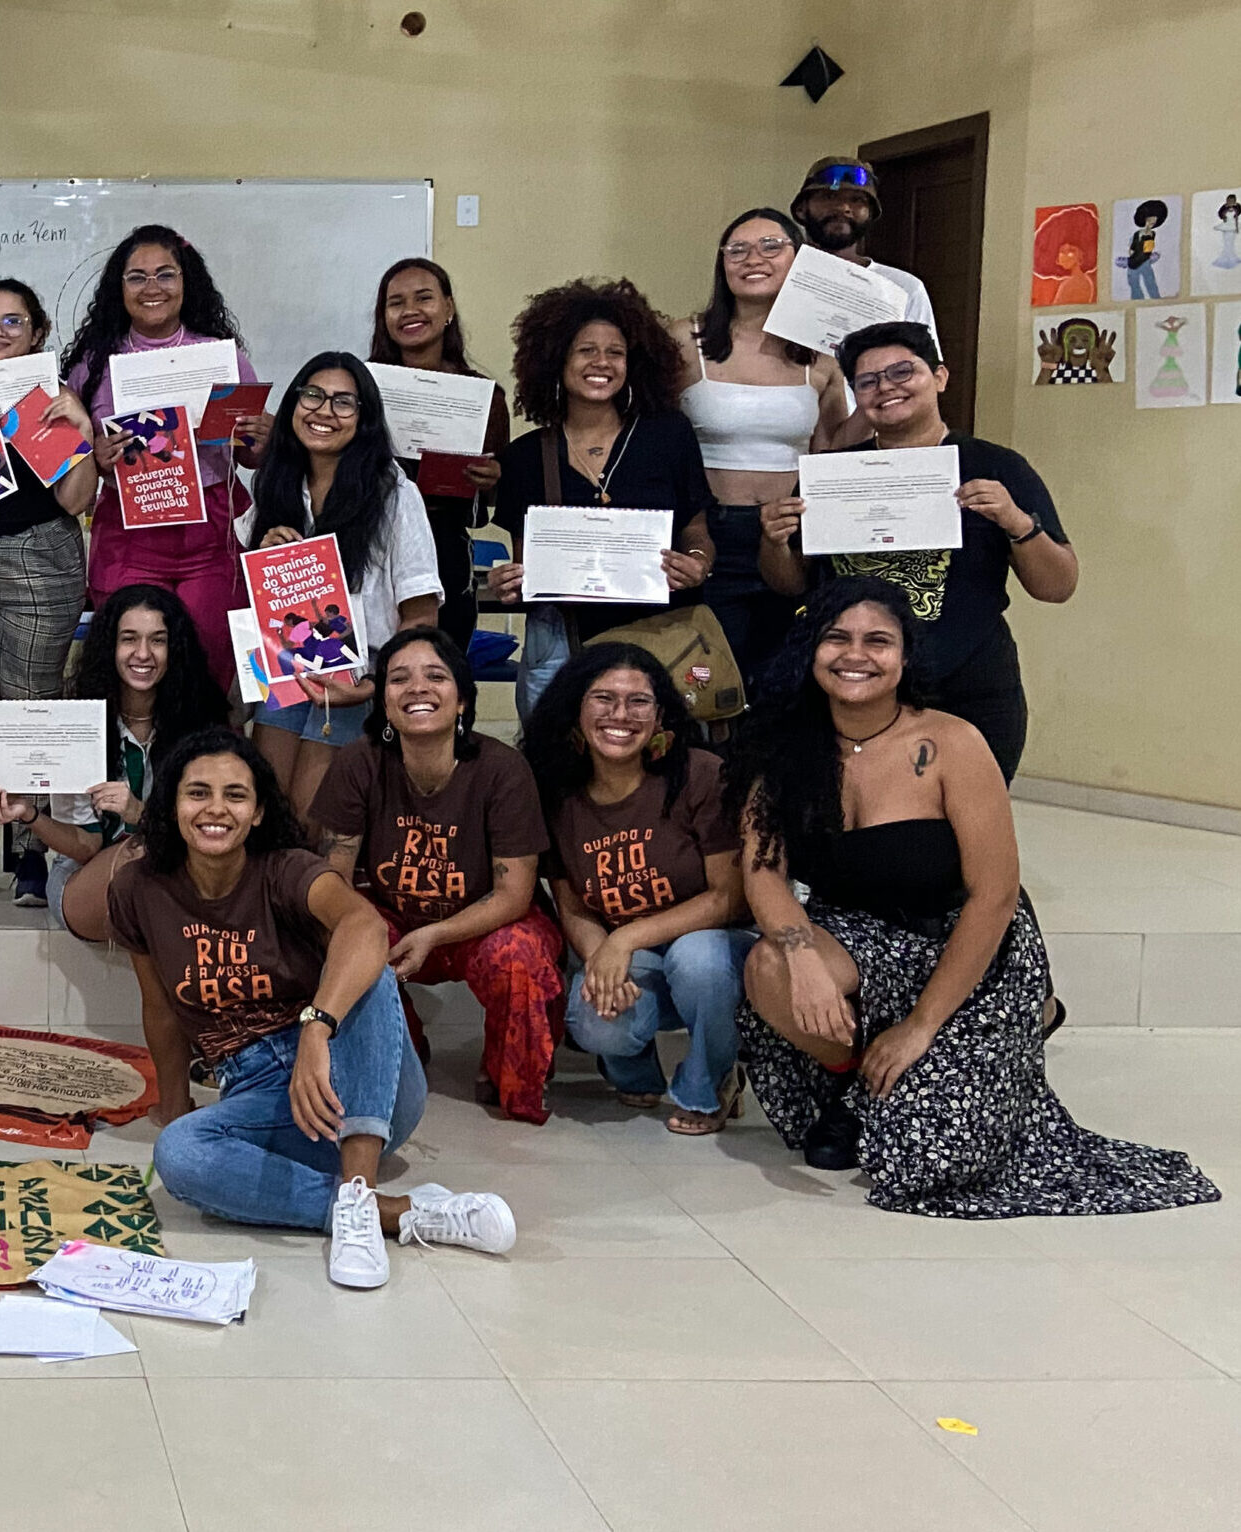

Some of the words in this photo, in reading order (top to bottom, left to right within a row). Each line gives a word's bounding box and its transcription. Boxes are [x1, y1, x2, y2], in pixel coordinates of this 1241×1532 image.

[13, 229, 26, 244] de
[127, 465, 185, 484] Mudanças
[135, 477, 183, 494] Fazendo
[133, 489, 174, 505] Mundo
[175, 485, 189, 497] do
[140, 496, 189, 513] Meninas
[262, 553, 318, 578] Meninas
[262, 577, 278, 590] do
[280, 562, 326, 584] Mundo
[268, 583, 335, 611] Mudanças
[270, 575, 325, 597] Fazendo
[396, 815, 441, 835] QUADO
[449, 825, 458, 837] O
[583, 828, 638, 854] QUANDO
[644, 828, 653, 840] O
[402, 855, 411, 866] A
[418, 857, 456, 872] NOSSA
[377, 861, 465, 898] CASA
[585, 878, 593, 892] É
[600, 877, 607, 890] A
[616, 867, 658, 886] NOSSA
[582, 876, 675, 916] CASA
[182, 923, 240, 942] QUANDO
[247, 929, 256, 942] O
[196, 938, 248, 966] RIO
[185, 964, 191, 980] É
[199, 967, 207, 979] A
[216, 964, 259, 978] NOSSA
[175, 974, 273, 1007] CASA
